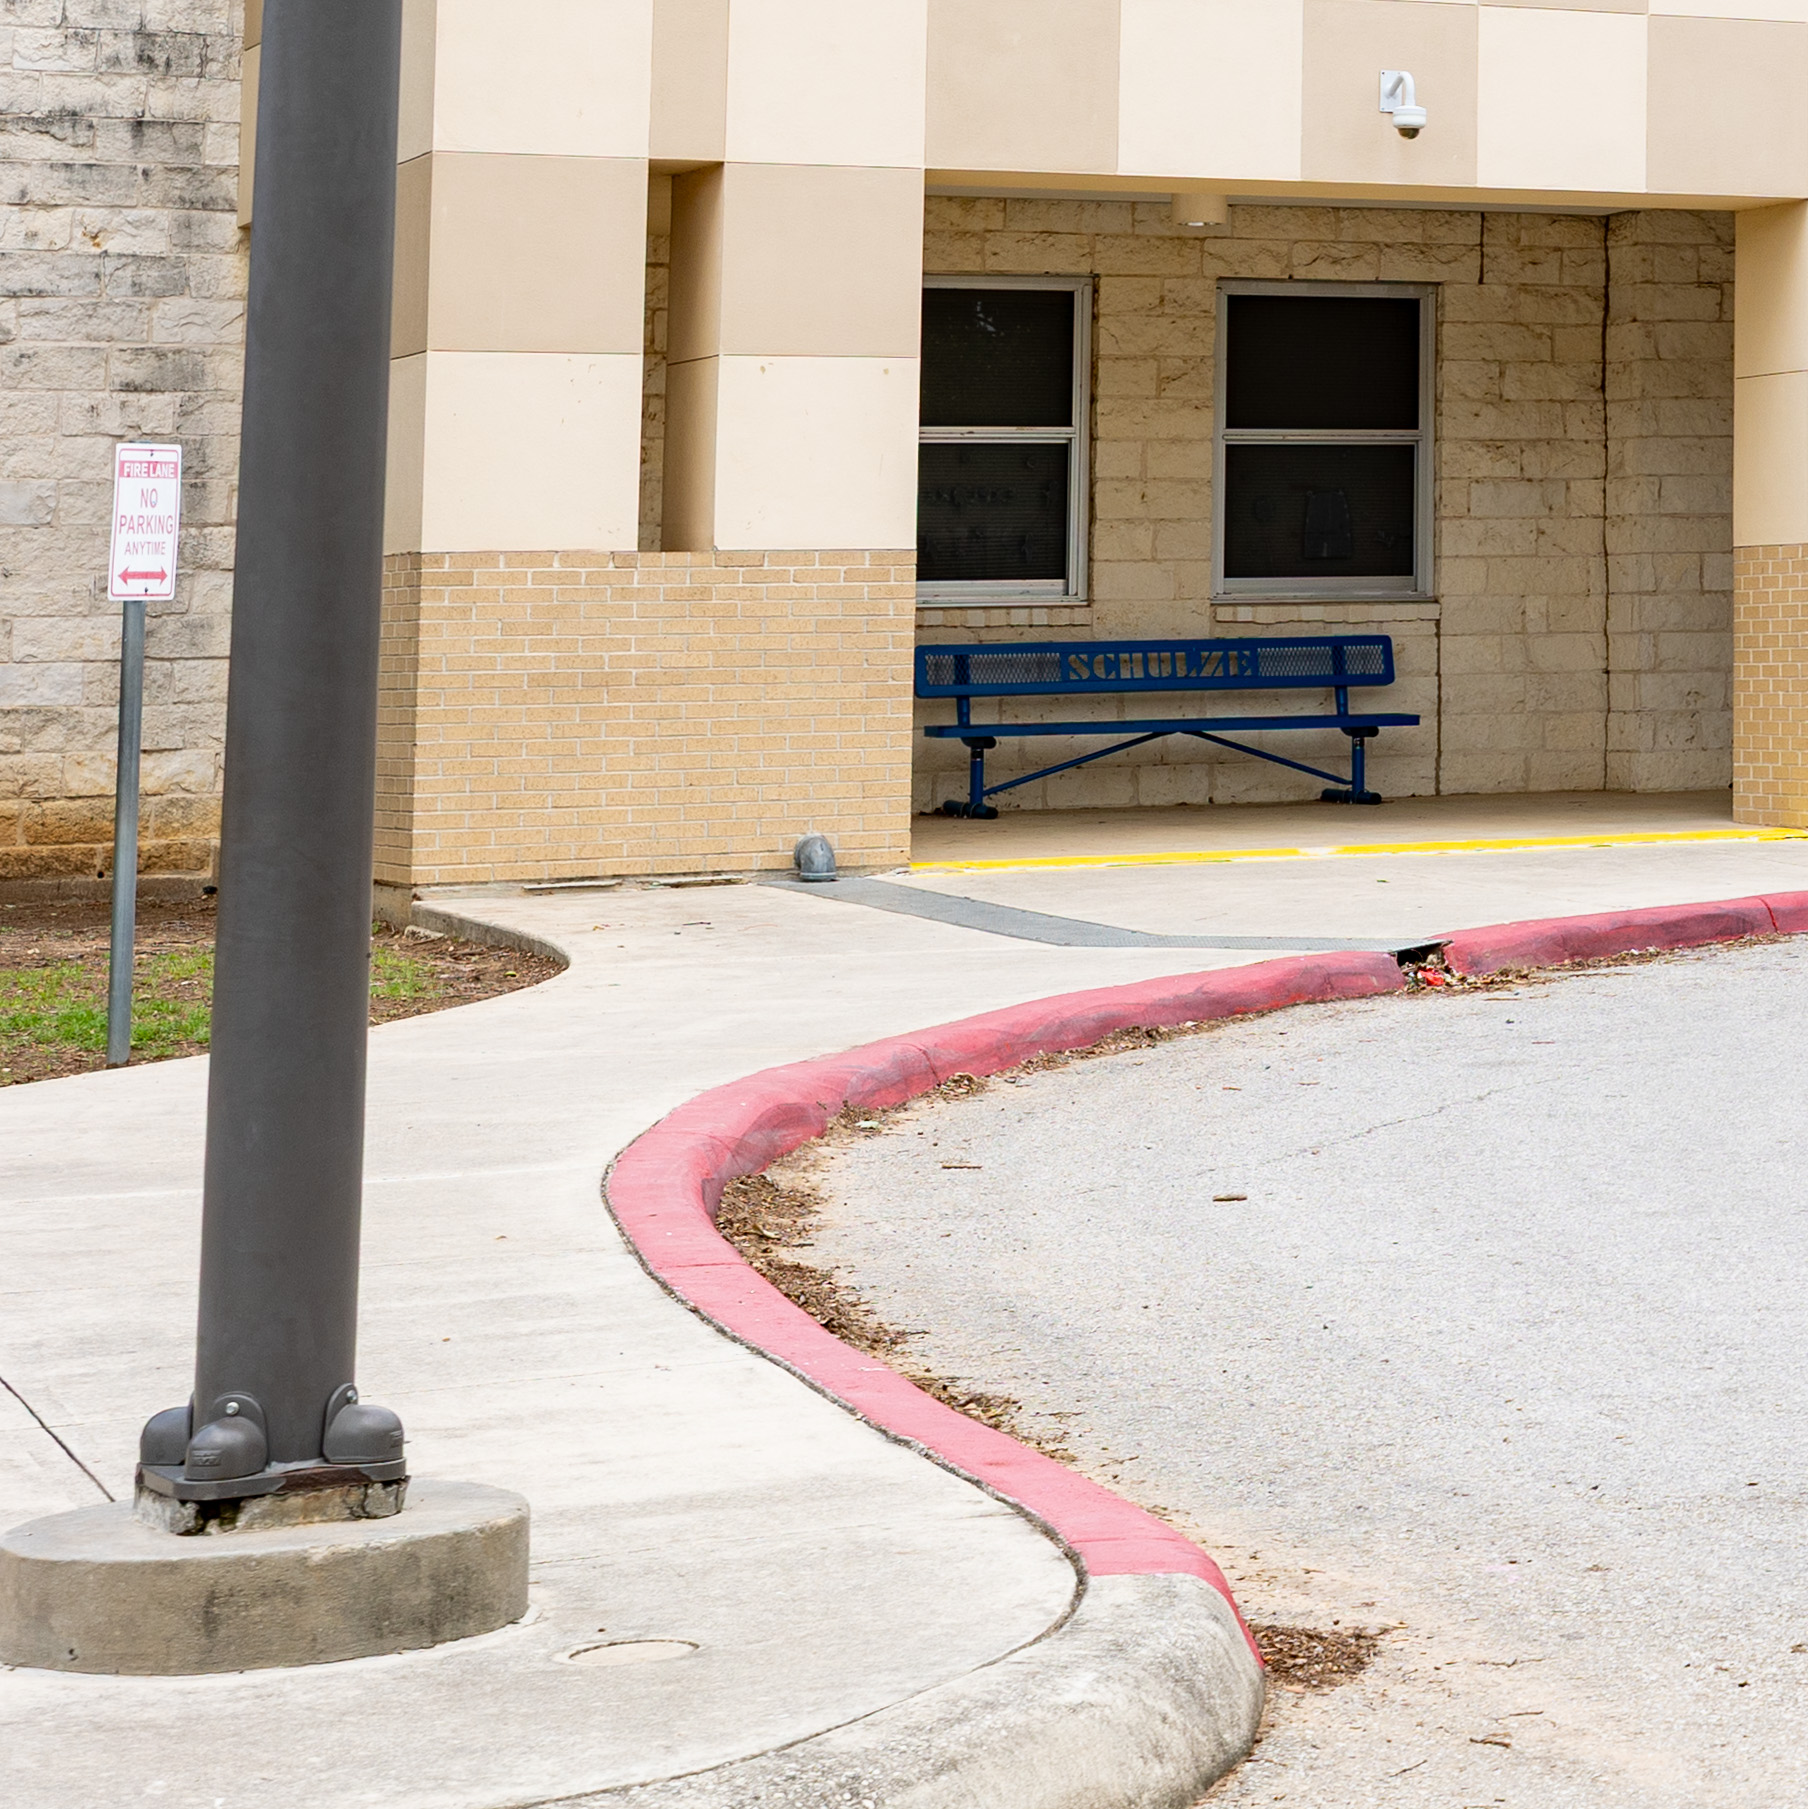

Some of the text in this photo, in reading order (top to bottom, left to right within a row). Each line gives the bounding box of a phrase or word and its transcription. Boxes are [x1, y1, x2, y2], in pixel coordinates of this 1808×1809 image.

[123, 462, 175, 478] FIRE LANE
[140, 488, 158, 508] NO
[119, 514, 174, 534] PARKING
[124, 541, 166, 555] ANYTIME
[1067, 650, 1253, 680] SCHULZE
